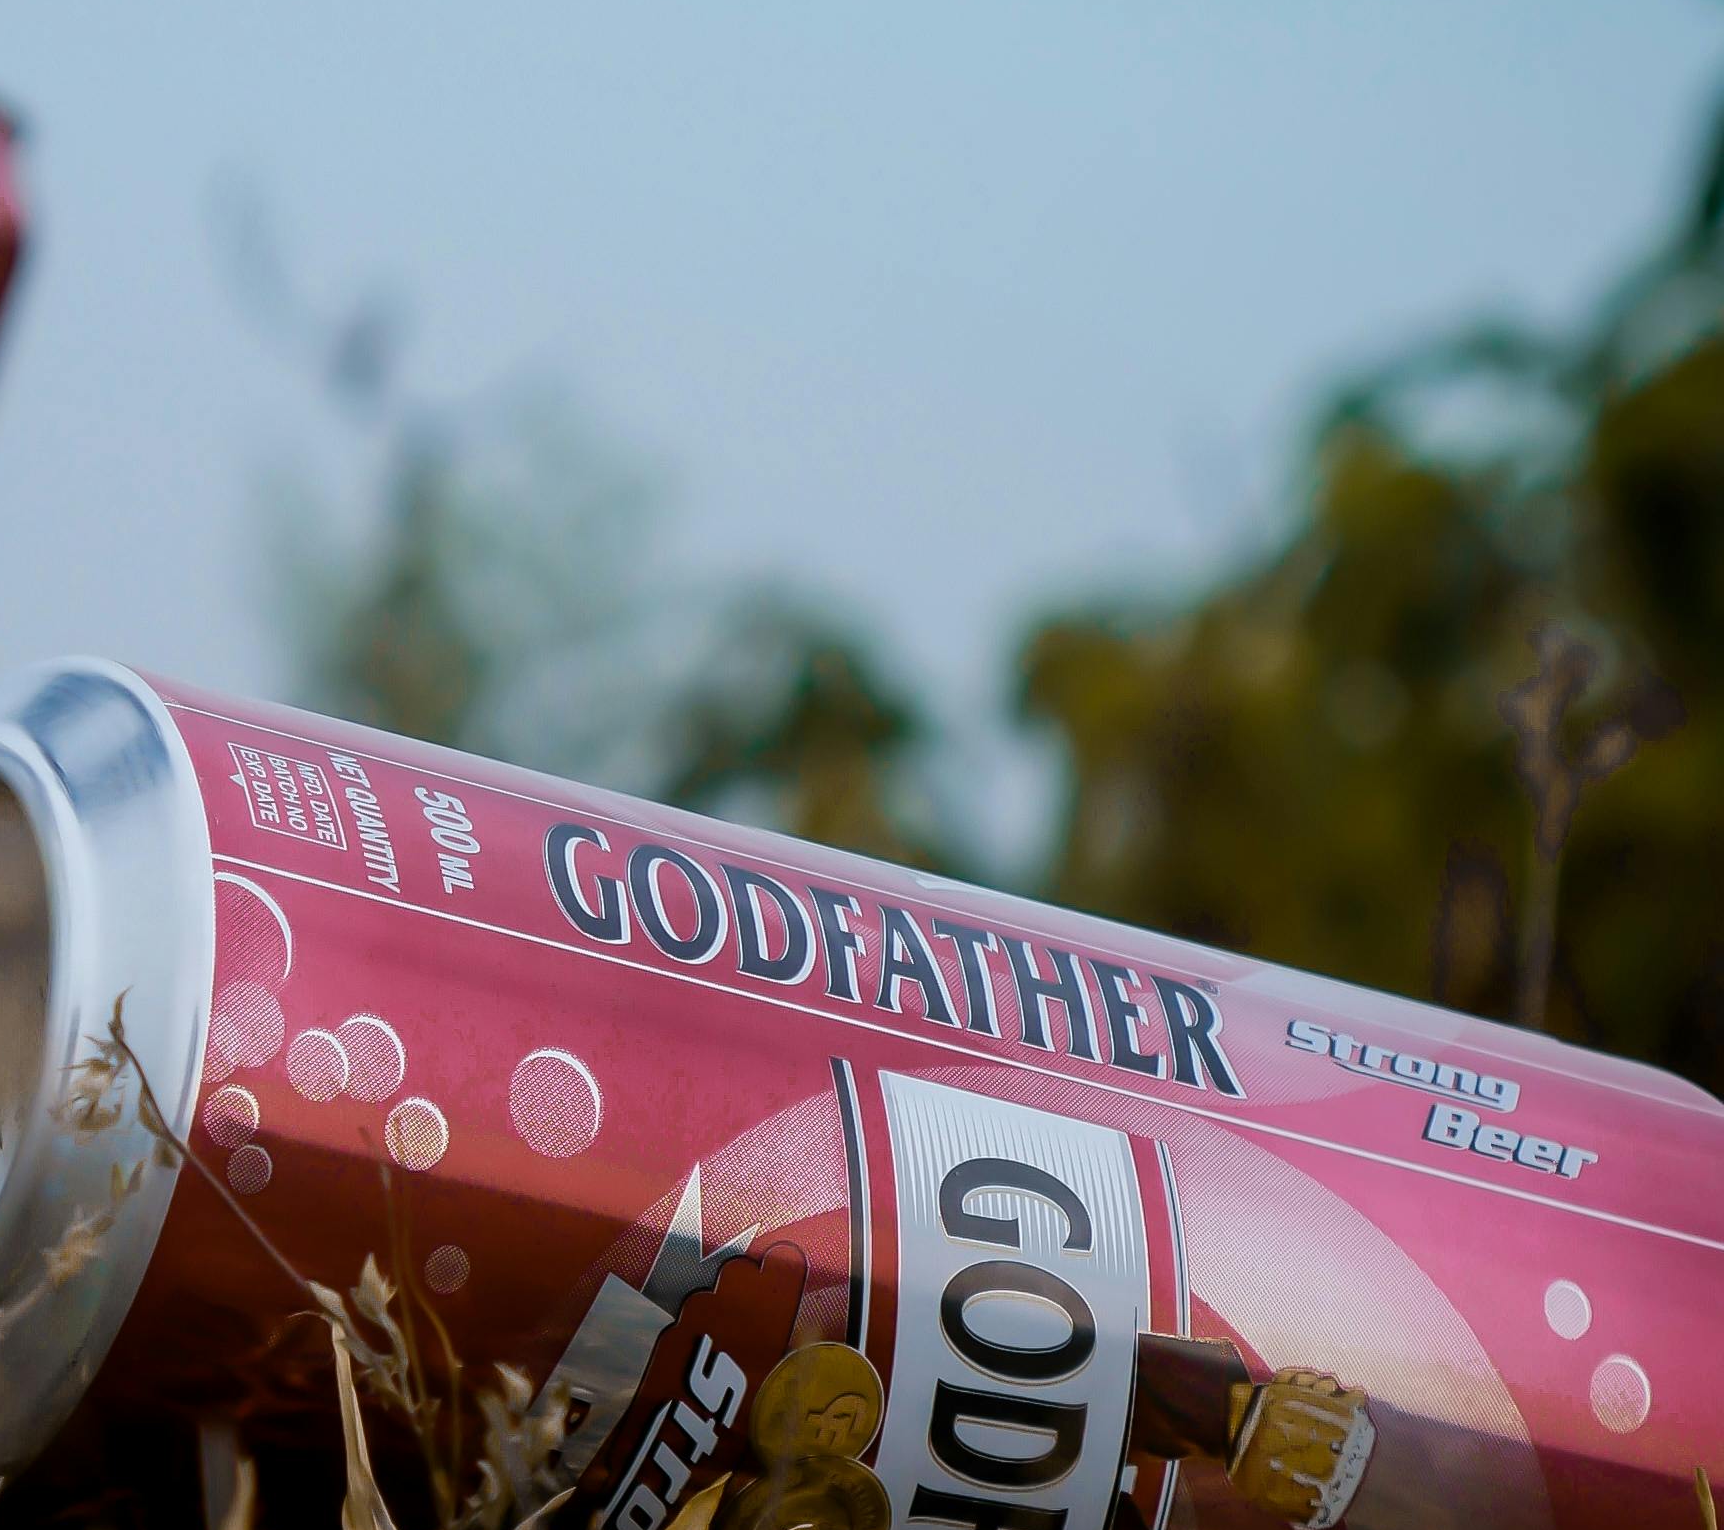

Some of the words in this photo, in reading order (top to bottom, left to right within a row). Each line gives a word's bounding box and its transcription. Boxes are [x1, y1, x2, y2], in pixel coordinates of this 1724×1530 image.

[267, 755, 302, 806] BATCH
[326, 751, 372, 789] NET
[251, 780, 281, 824] DATE
[284, 804, 308, 832] NO
[309, 799, 338, 844] DATE
[413, 785, 482, 856] 500
[344, 786, 401, 894] QUANTITY
[435, 853, 475, 896] ML
[542, 821, 1248, 1099] GODFATHER
[1284, 1019, 1521, 1113] Strong
[1420, 1101, 1599, 1180] Beer
